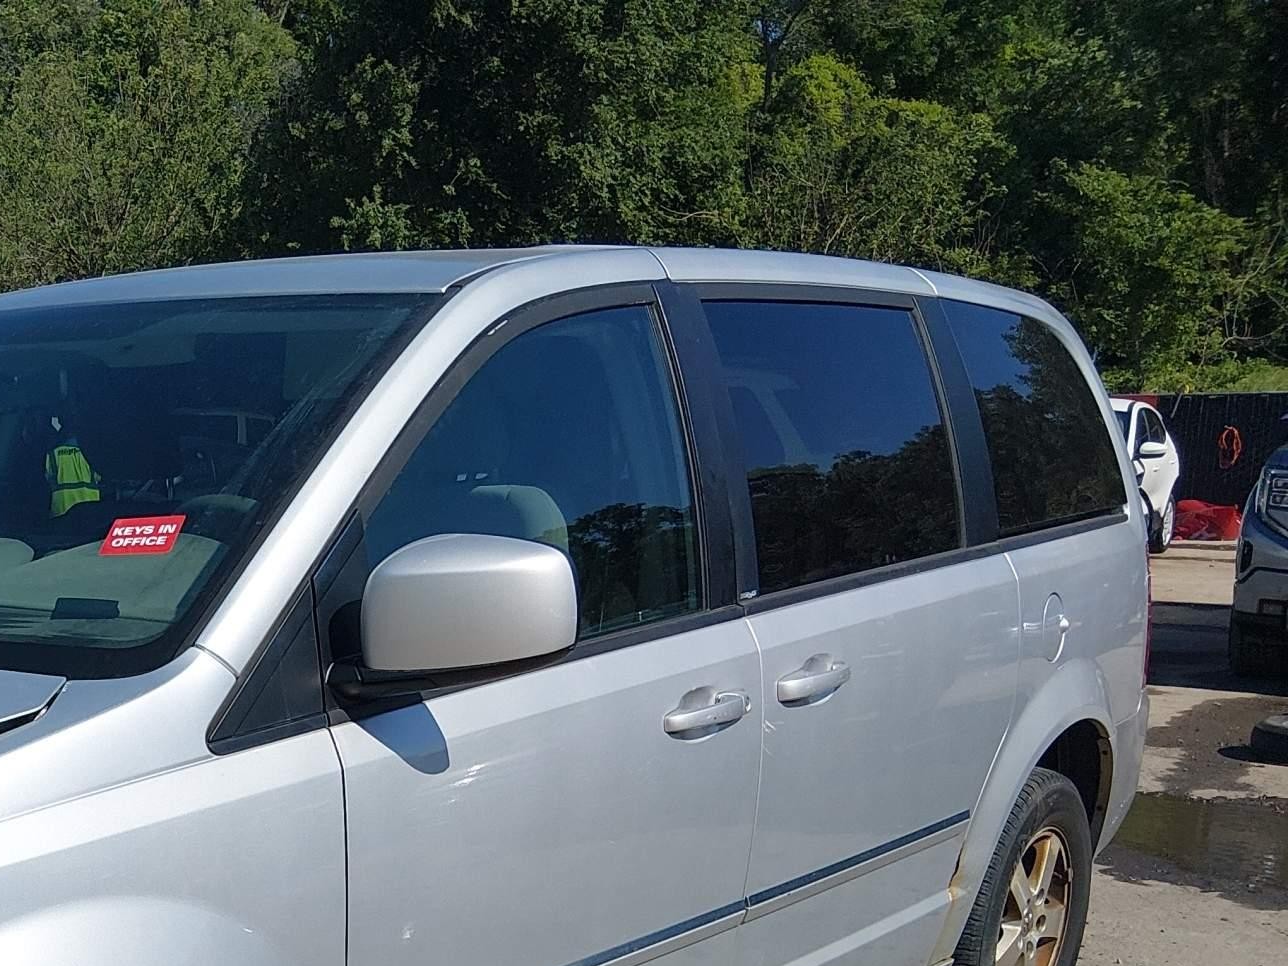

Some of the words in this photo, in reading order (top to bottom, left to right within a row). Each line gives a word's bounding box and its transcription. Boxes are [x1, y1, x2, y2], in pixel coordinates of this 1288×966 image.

[112, 525, 155, 536] KEYS
[158, 524, 178, 534] IN
[111, 536, 168, 547] OFFICE
